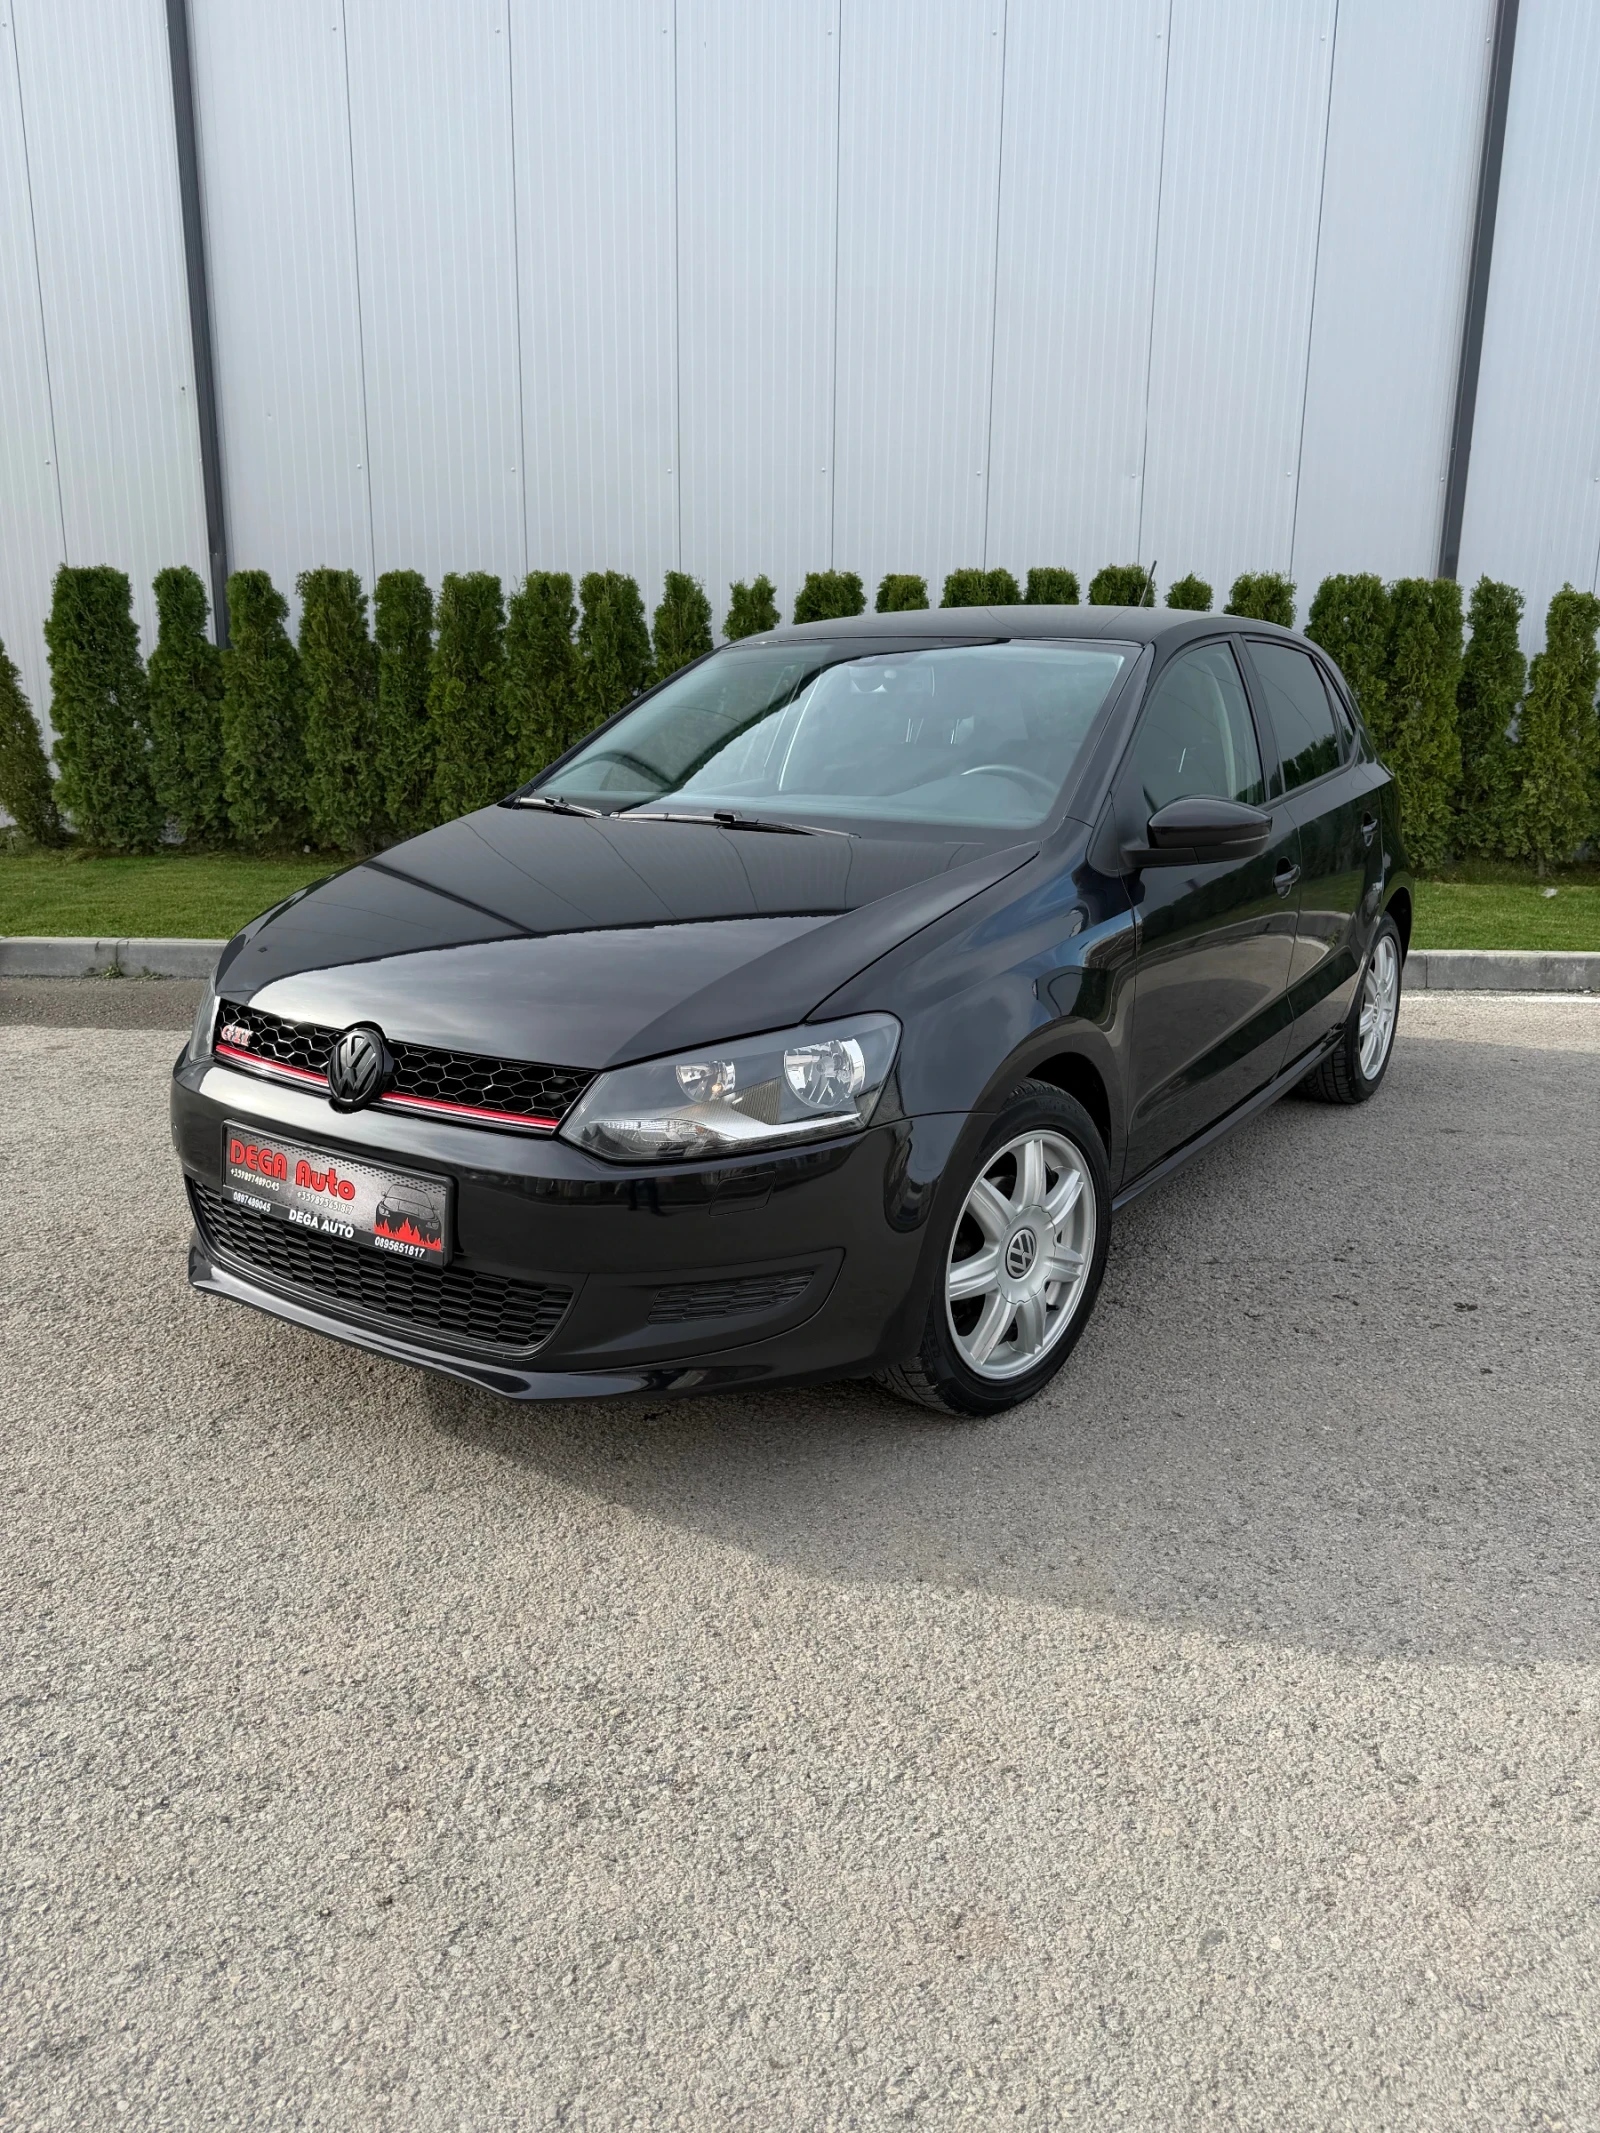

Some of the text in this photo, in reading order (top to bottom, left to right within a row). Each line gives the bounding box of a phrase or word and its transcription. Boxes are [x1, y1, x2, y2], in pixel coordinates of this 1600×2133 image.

[230, 1138, 355, 1201] DEGA Auto
[233, 1191, 271, 1212] 0897489045
[289, 1209, 354, 1238] DEGA AUTO
[375, 1236, 425, 1258] 0895651817
